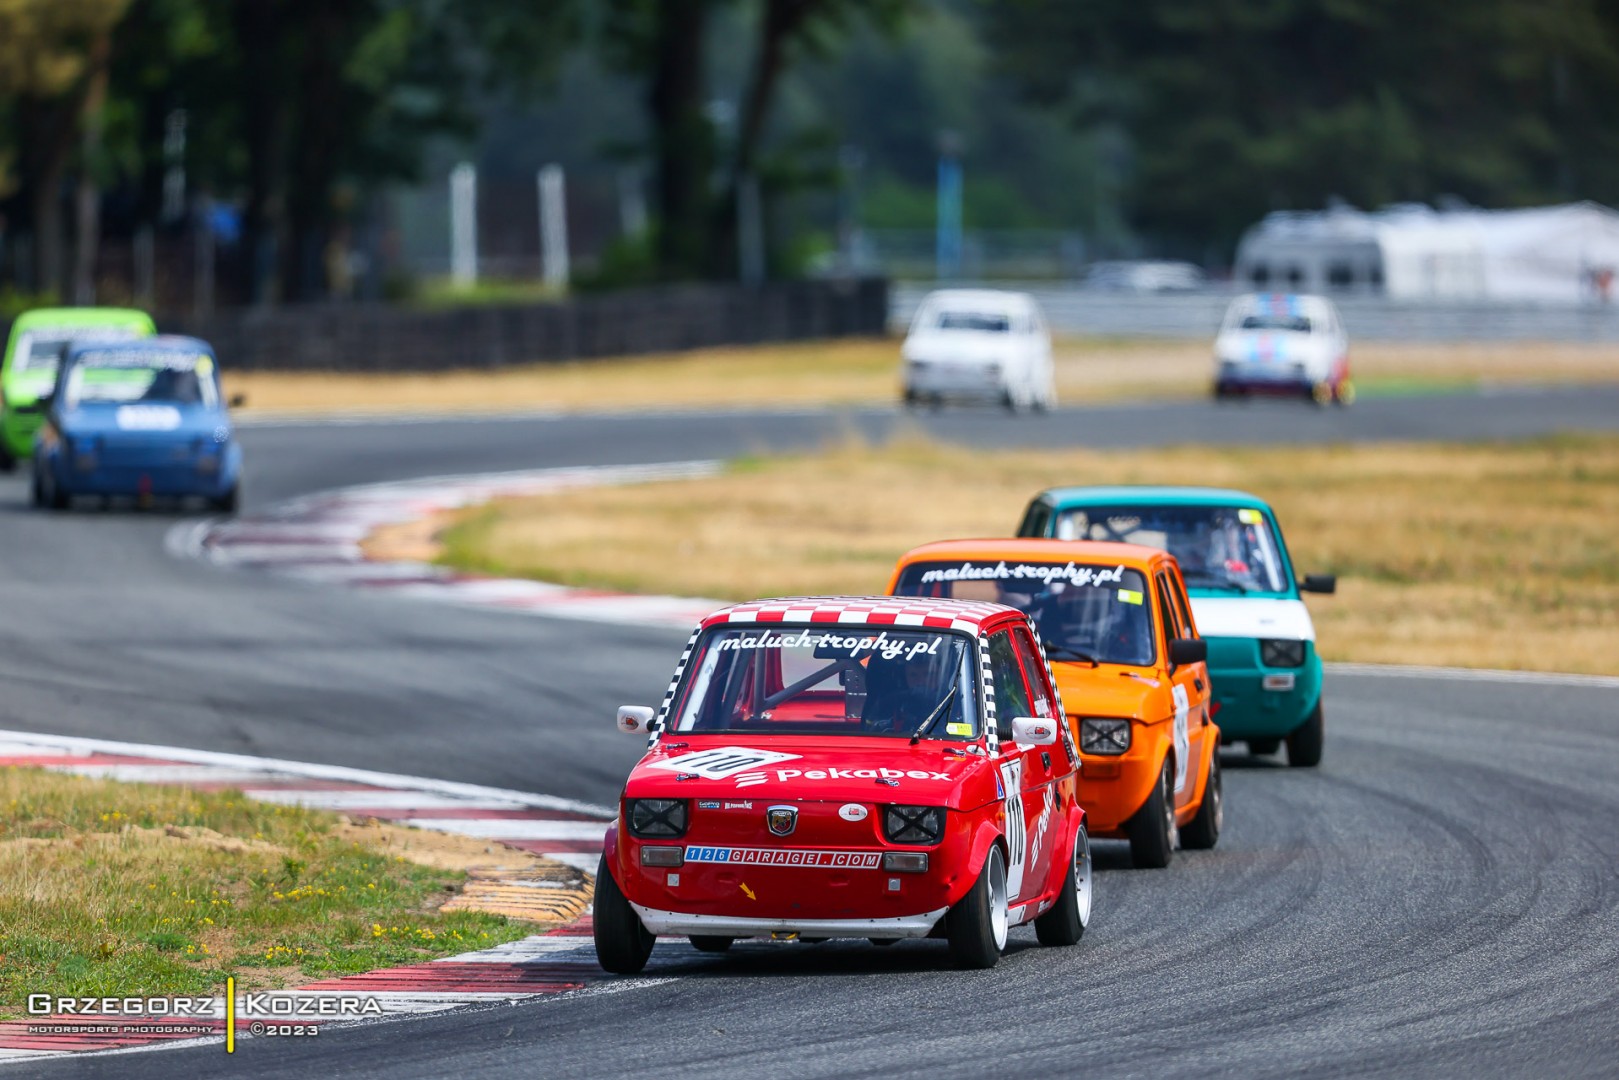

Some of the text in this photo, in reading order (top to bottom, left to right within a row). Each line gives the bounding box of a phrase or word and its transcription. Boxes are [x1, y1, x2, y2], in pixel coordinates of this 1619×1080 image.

[921, 561, 1125, 587] maluch-trophy.pl
[717, 629, 943, 661] maluch-trophy.pl
[672, 752, 765, 772] 110
[1007, 795, 1024, 867] 110
[688, 848, 879, 866] 126GARAGE.COM
